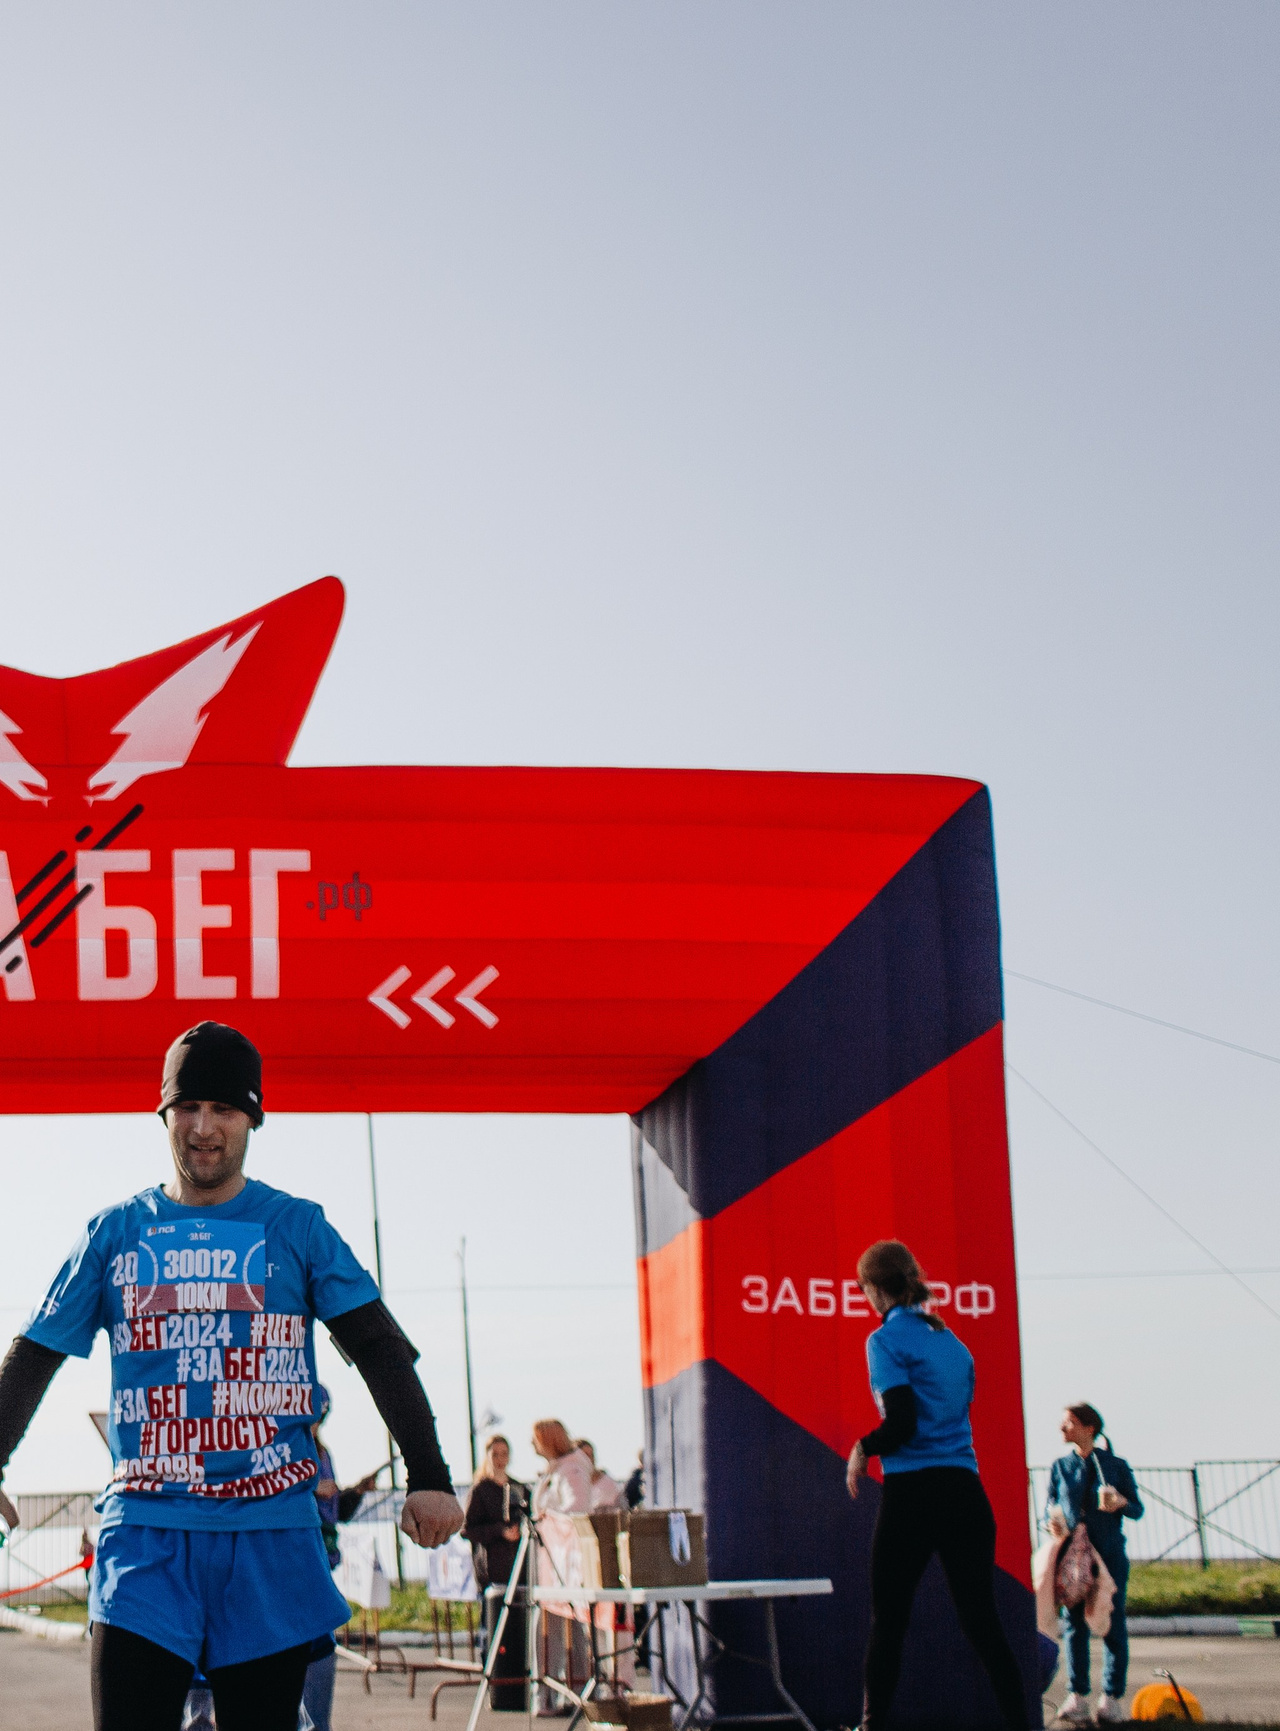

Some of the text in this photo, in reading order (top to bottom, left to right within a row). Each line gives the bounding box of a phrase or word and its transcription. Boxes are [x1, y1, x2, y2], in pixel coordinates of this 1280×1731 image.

[163, 1248, 237, 1280] 30012
[213, 1382, 314, 1416] #МОМЕНТ
[140, 1415, 279, 1456] #ГОРДОСТЬ
